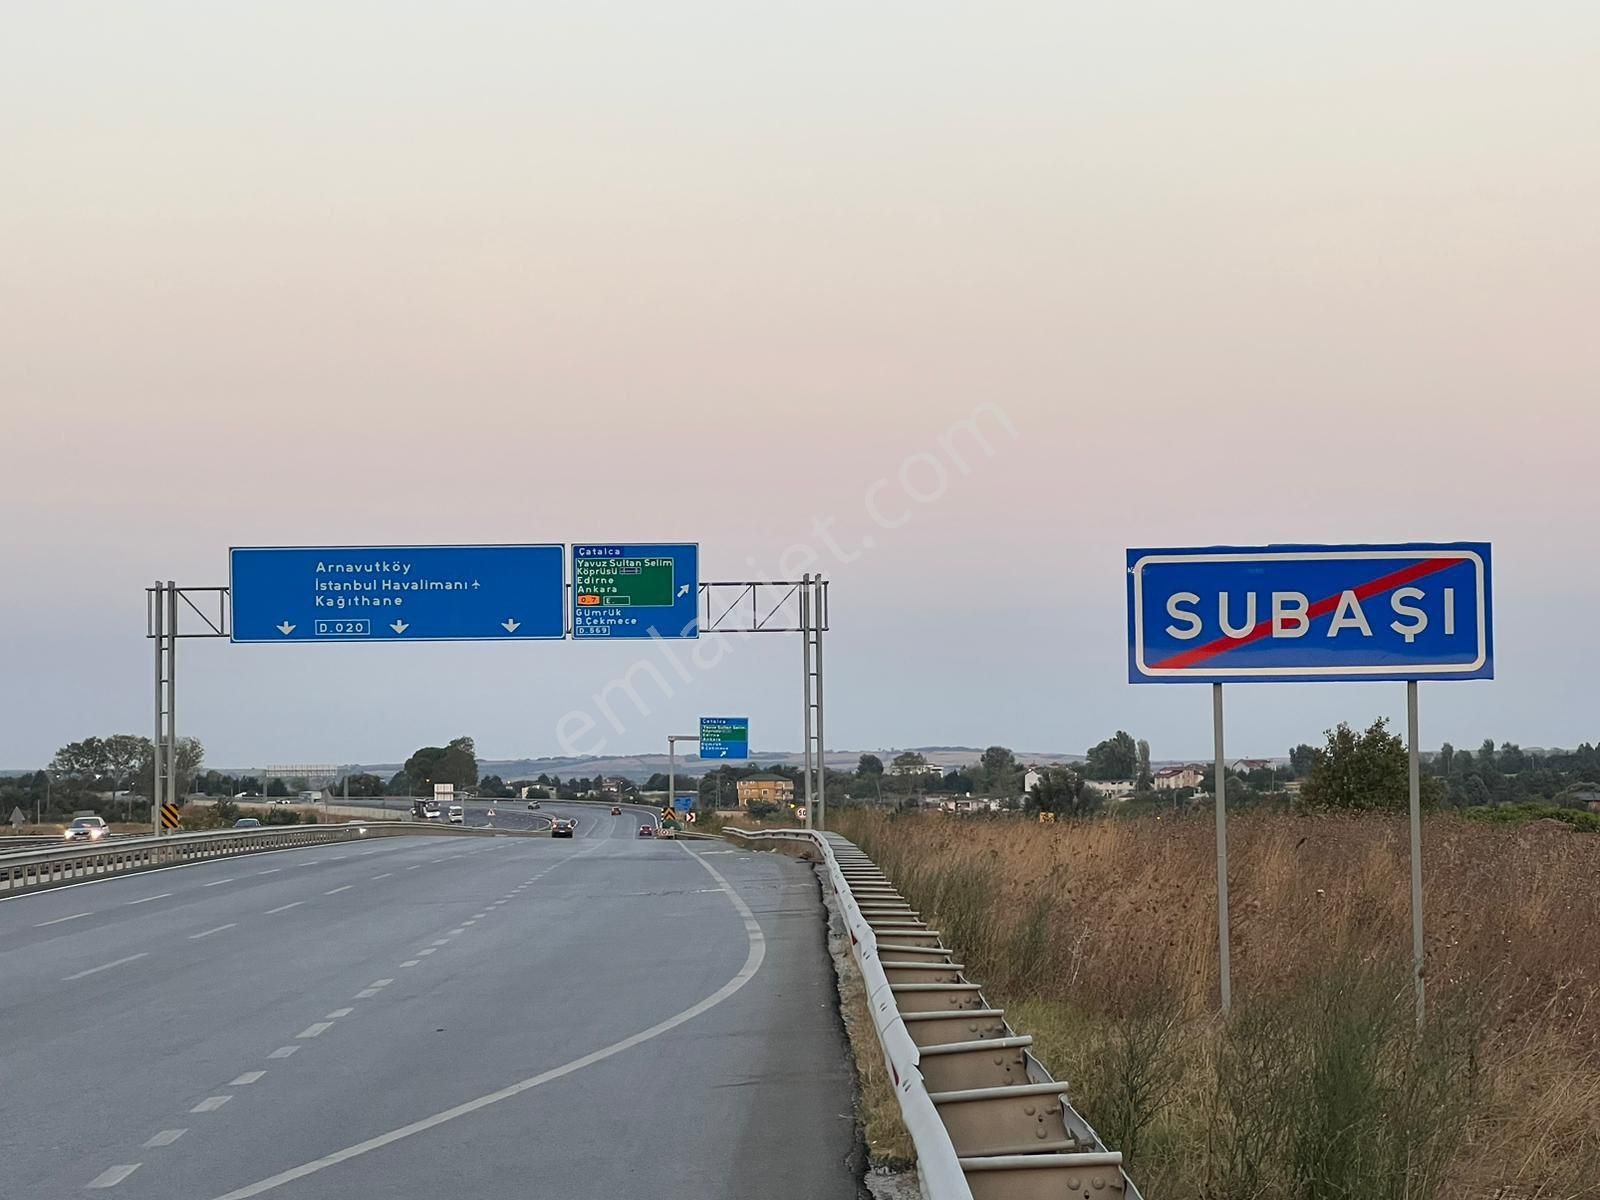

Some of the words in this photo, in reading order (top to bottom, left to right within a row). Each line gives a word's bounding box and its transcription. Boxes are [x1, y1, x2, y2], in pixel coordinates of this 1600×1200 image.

[578, 547, 621, 556] Çatalca
[316, 561, 411, 574] Arnavutköy
[577, 559, 608, 568] Yavuz
[609, 559, 642, 568] Sultan
[644, 559, 673, 568] Selim
[577, 568, 618, 576] Köprüsü
[315, 578, 377, 591] İstanbul
[382, 579, 468, 591] Havalimanı
[315, 595, 403, 609] Kağıthane
[576, 608, 622, 616] Gümrük
[1165, 587, 1455, 643] SUBAŞI
[319, 623, 364, 633] D.020
